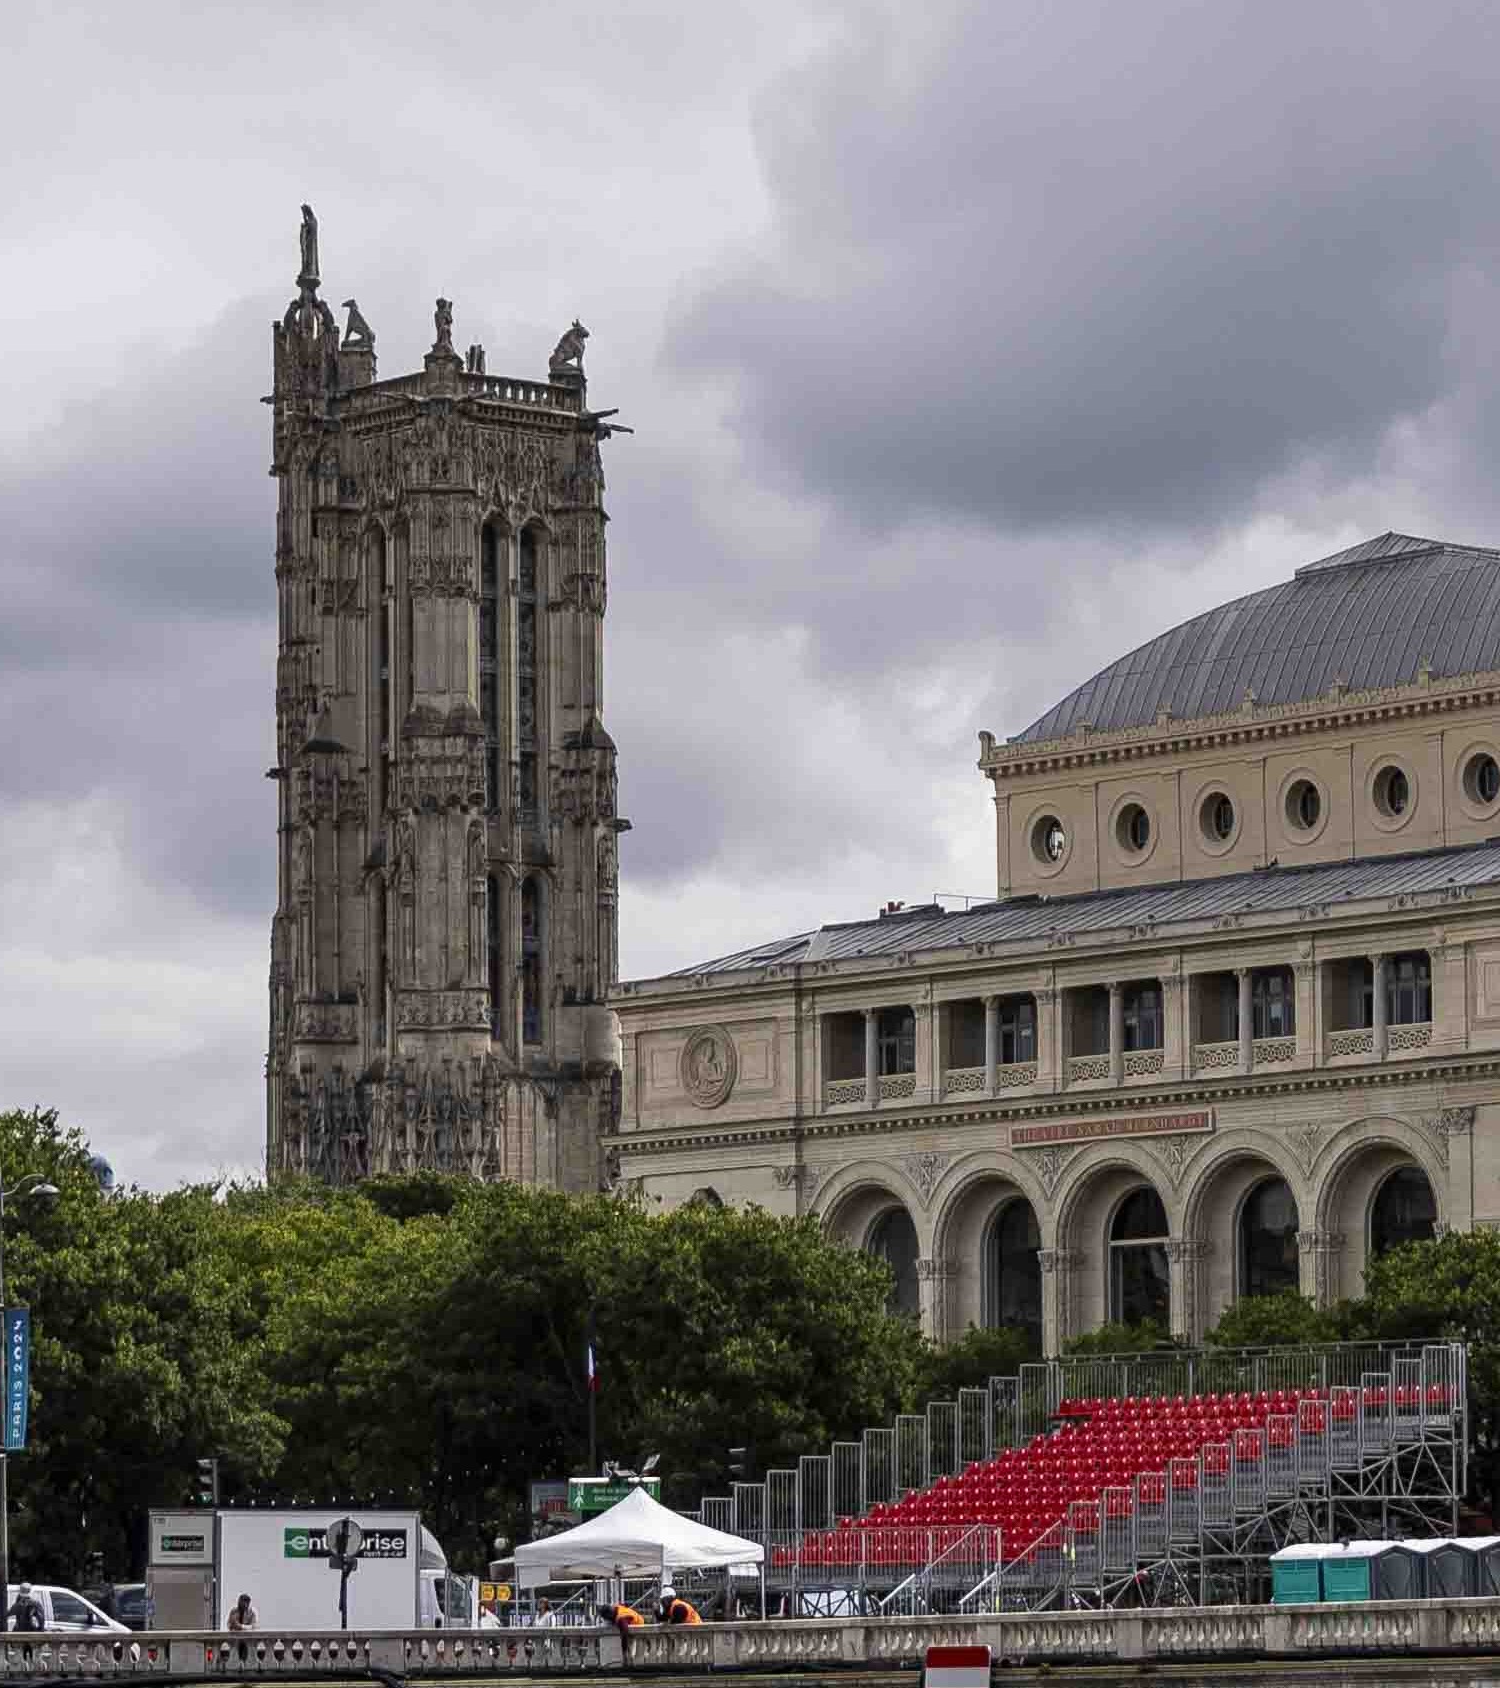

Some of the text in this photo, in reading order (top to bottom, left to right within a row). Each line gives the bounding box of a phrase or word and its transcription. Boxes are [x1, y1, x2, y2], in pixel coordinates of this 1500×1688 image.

[12, 1320, 23, 1438] PARIS 2024
[287, 1533, 405, 1551] entrise
